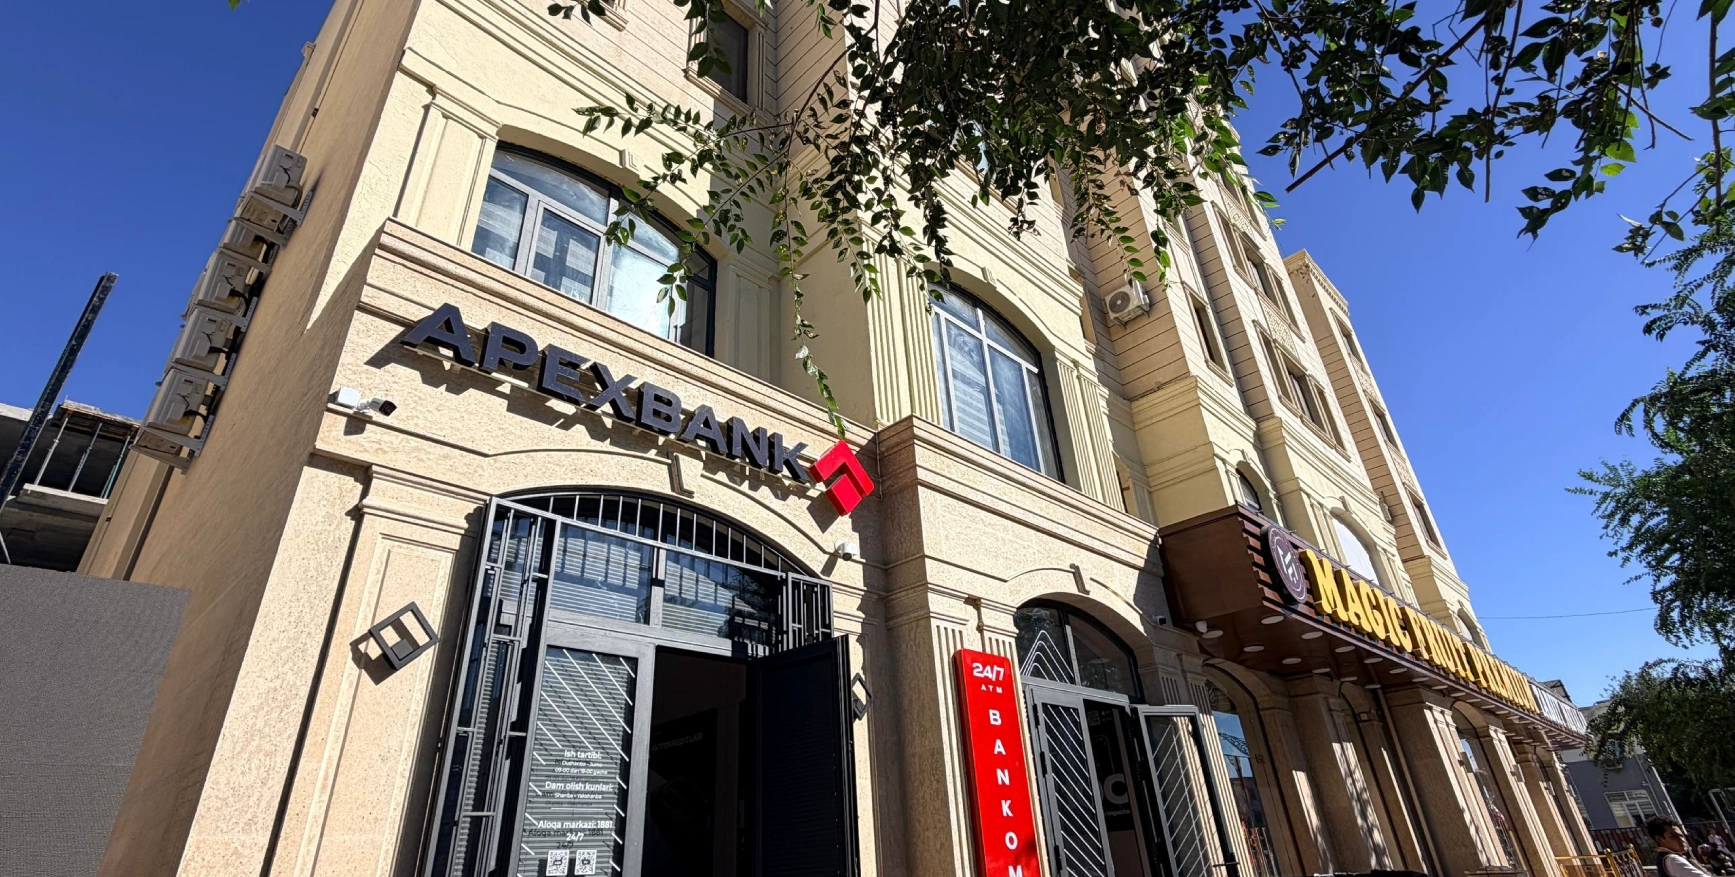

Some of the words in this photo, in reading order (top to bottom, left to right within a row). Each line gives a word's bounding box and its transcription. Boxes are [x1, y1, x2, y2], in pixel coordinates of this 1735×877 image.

[401, 302, 811, 483] APEXBANK
[1301, 548, 1412, 653] MAGIC
[1402, 606, 1475, 682] FRUIT
[1464, 641, 1540, 714] PREMIUM
[972, 662, 1004, 682] 24/7
[980, 683, 1003, 694] ATM
[564, 750, 576, 758] Ish
[545, 781, 565, 790] Dam
[565, 782, 585, 790] olish
[585, 782, 613, 791] kunlari:
[538, 820, 562, 829] Aloqa
[563, 820, 597, 829] markazi:
[597, 820, 613, 829] 1881
[565, 832, 585, 842] 24/7
